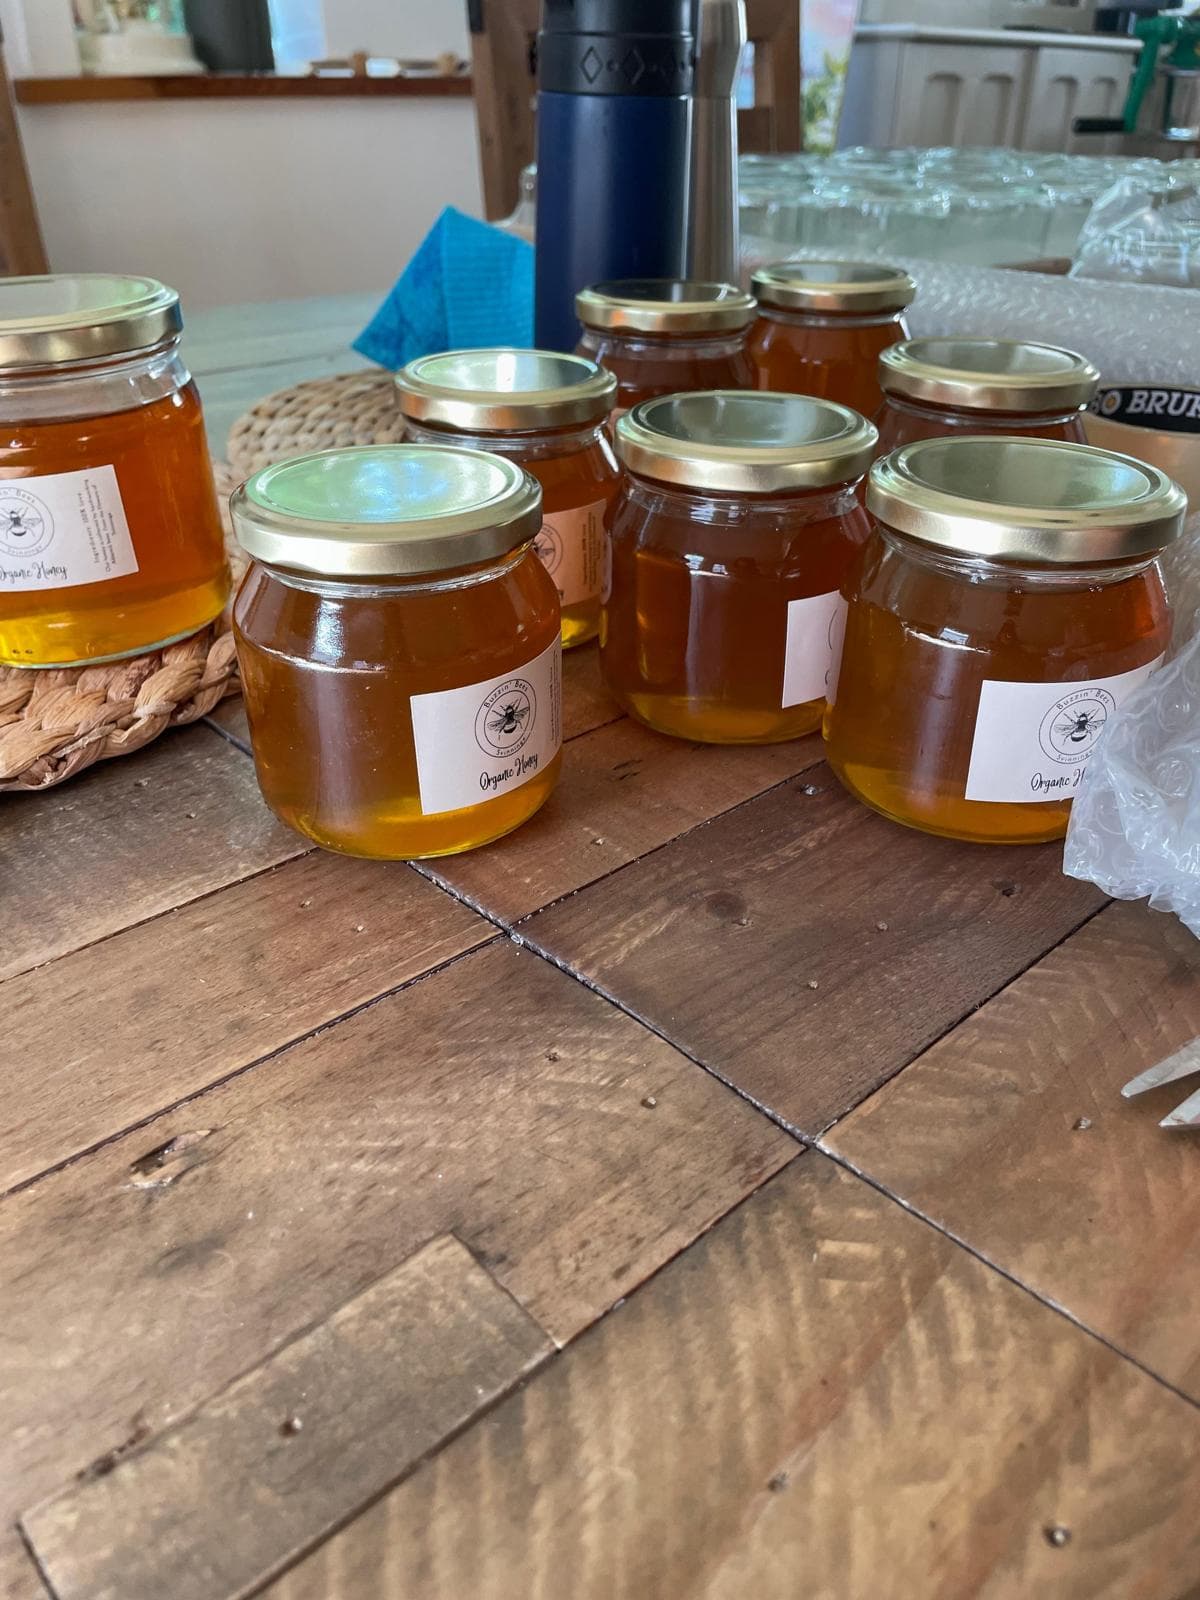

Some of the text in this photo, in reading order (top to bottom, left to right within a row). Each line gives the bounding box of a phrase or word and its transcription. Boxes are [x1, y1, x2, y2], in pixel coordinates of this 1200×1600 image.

[32, 561, 68, 579] Honey
[514, 680, 529, 691] Bees
[1095, 689, 1110, 704] Bees
[480, 753, 538, 791] Organic Honey
[1030, 772, 1070, 794] Organic
